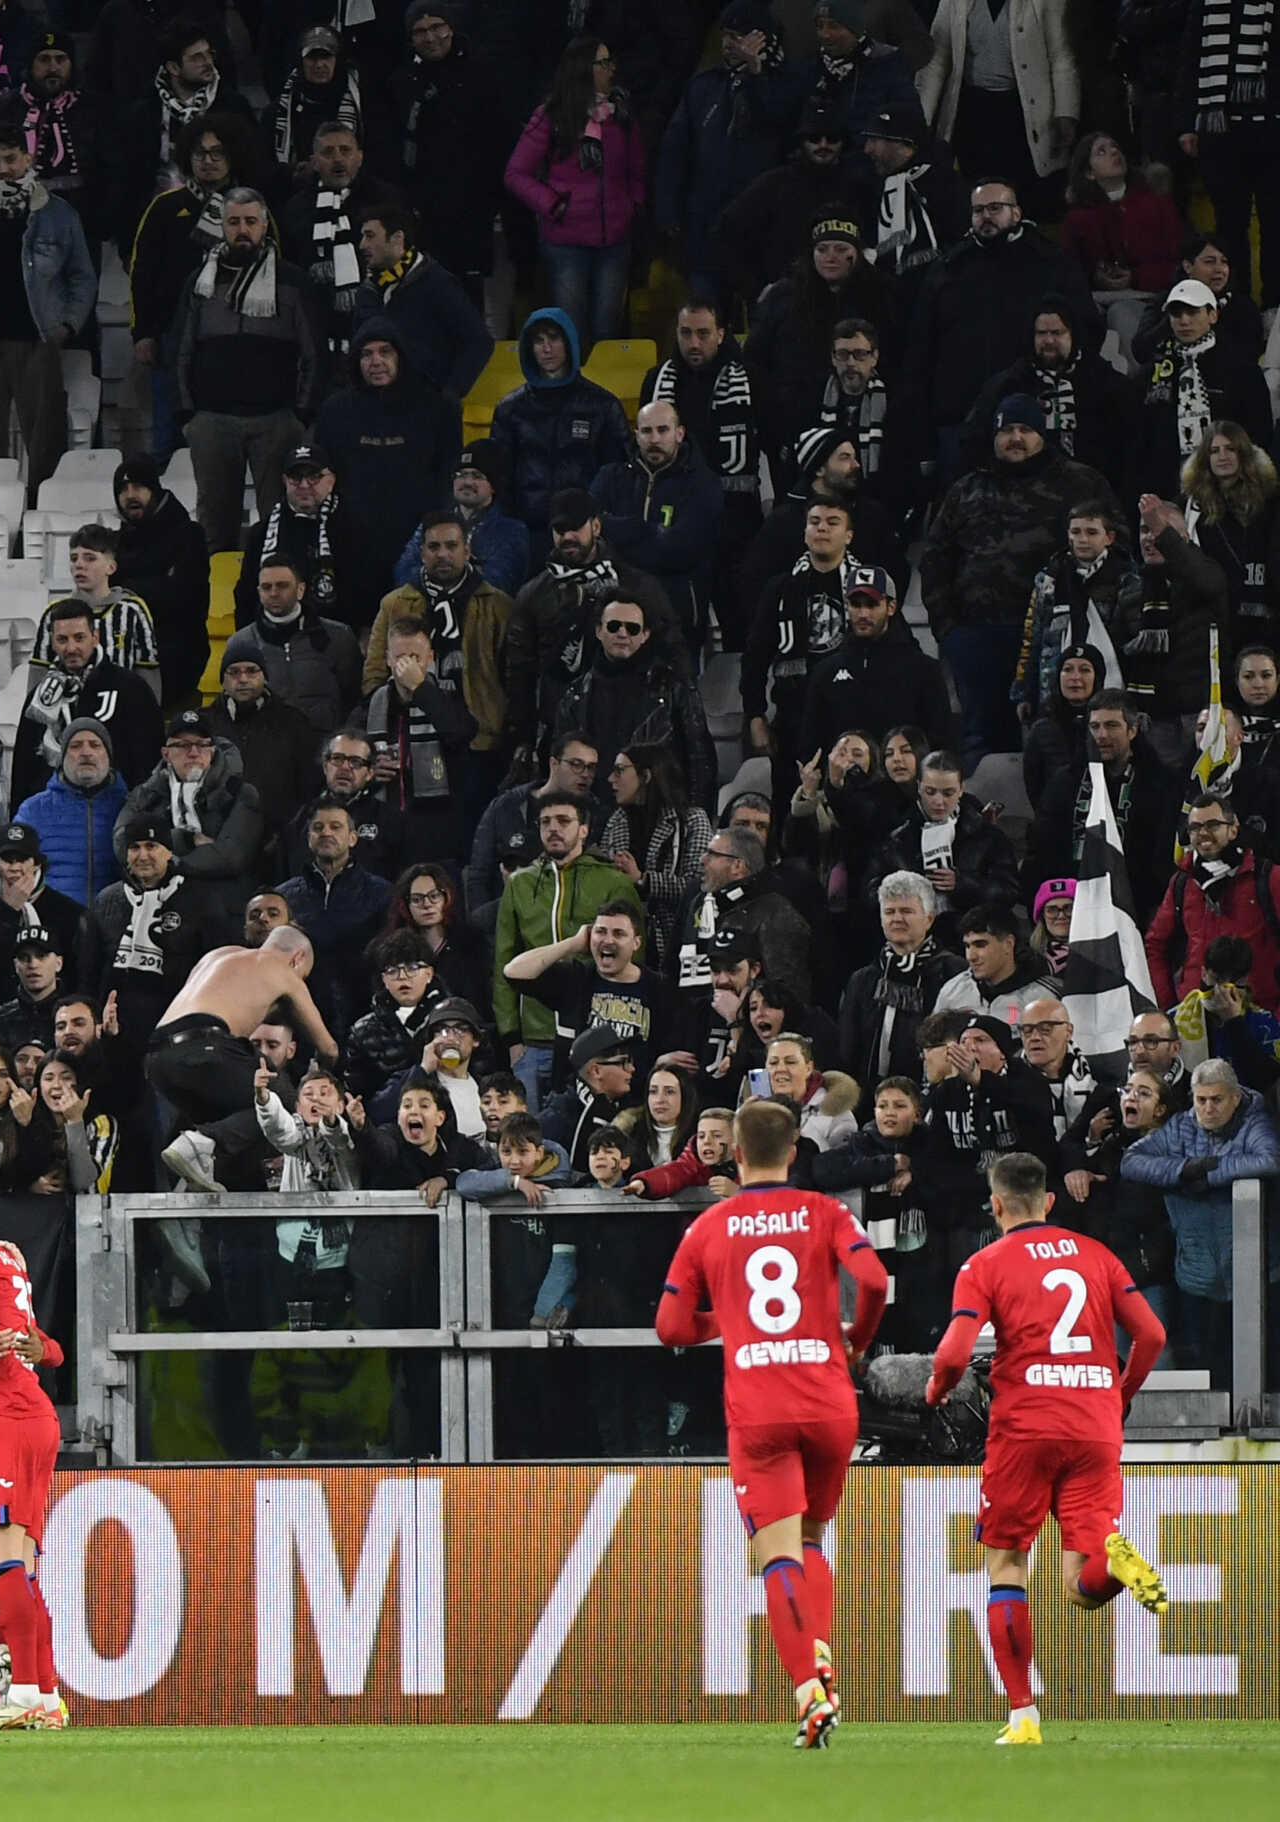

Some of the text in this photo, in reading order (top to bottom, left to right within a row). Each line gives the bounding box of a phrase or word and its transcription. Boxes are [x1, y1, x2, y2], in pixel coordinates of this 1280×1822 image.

[16, 928, 49, 944] ICON
[591, 1016, 634, 1038] ANTA
[726, 1205, 811, 1238] PAŠALIĆ
[1024, 1238, 1080, 1261] TOLOI
[745, 1244, 802, 1335] 8
[1041, 1268, 1093, 1355] 2
